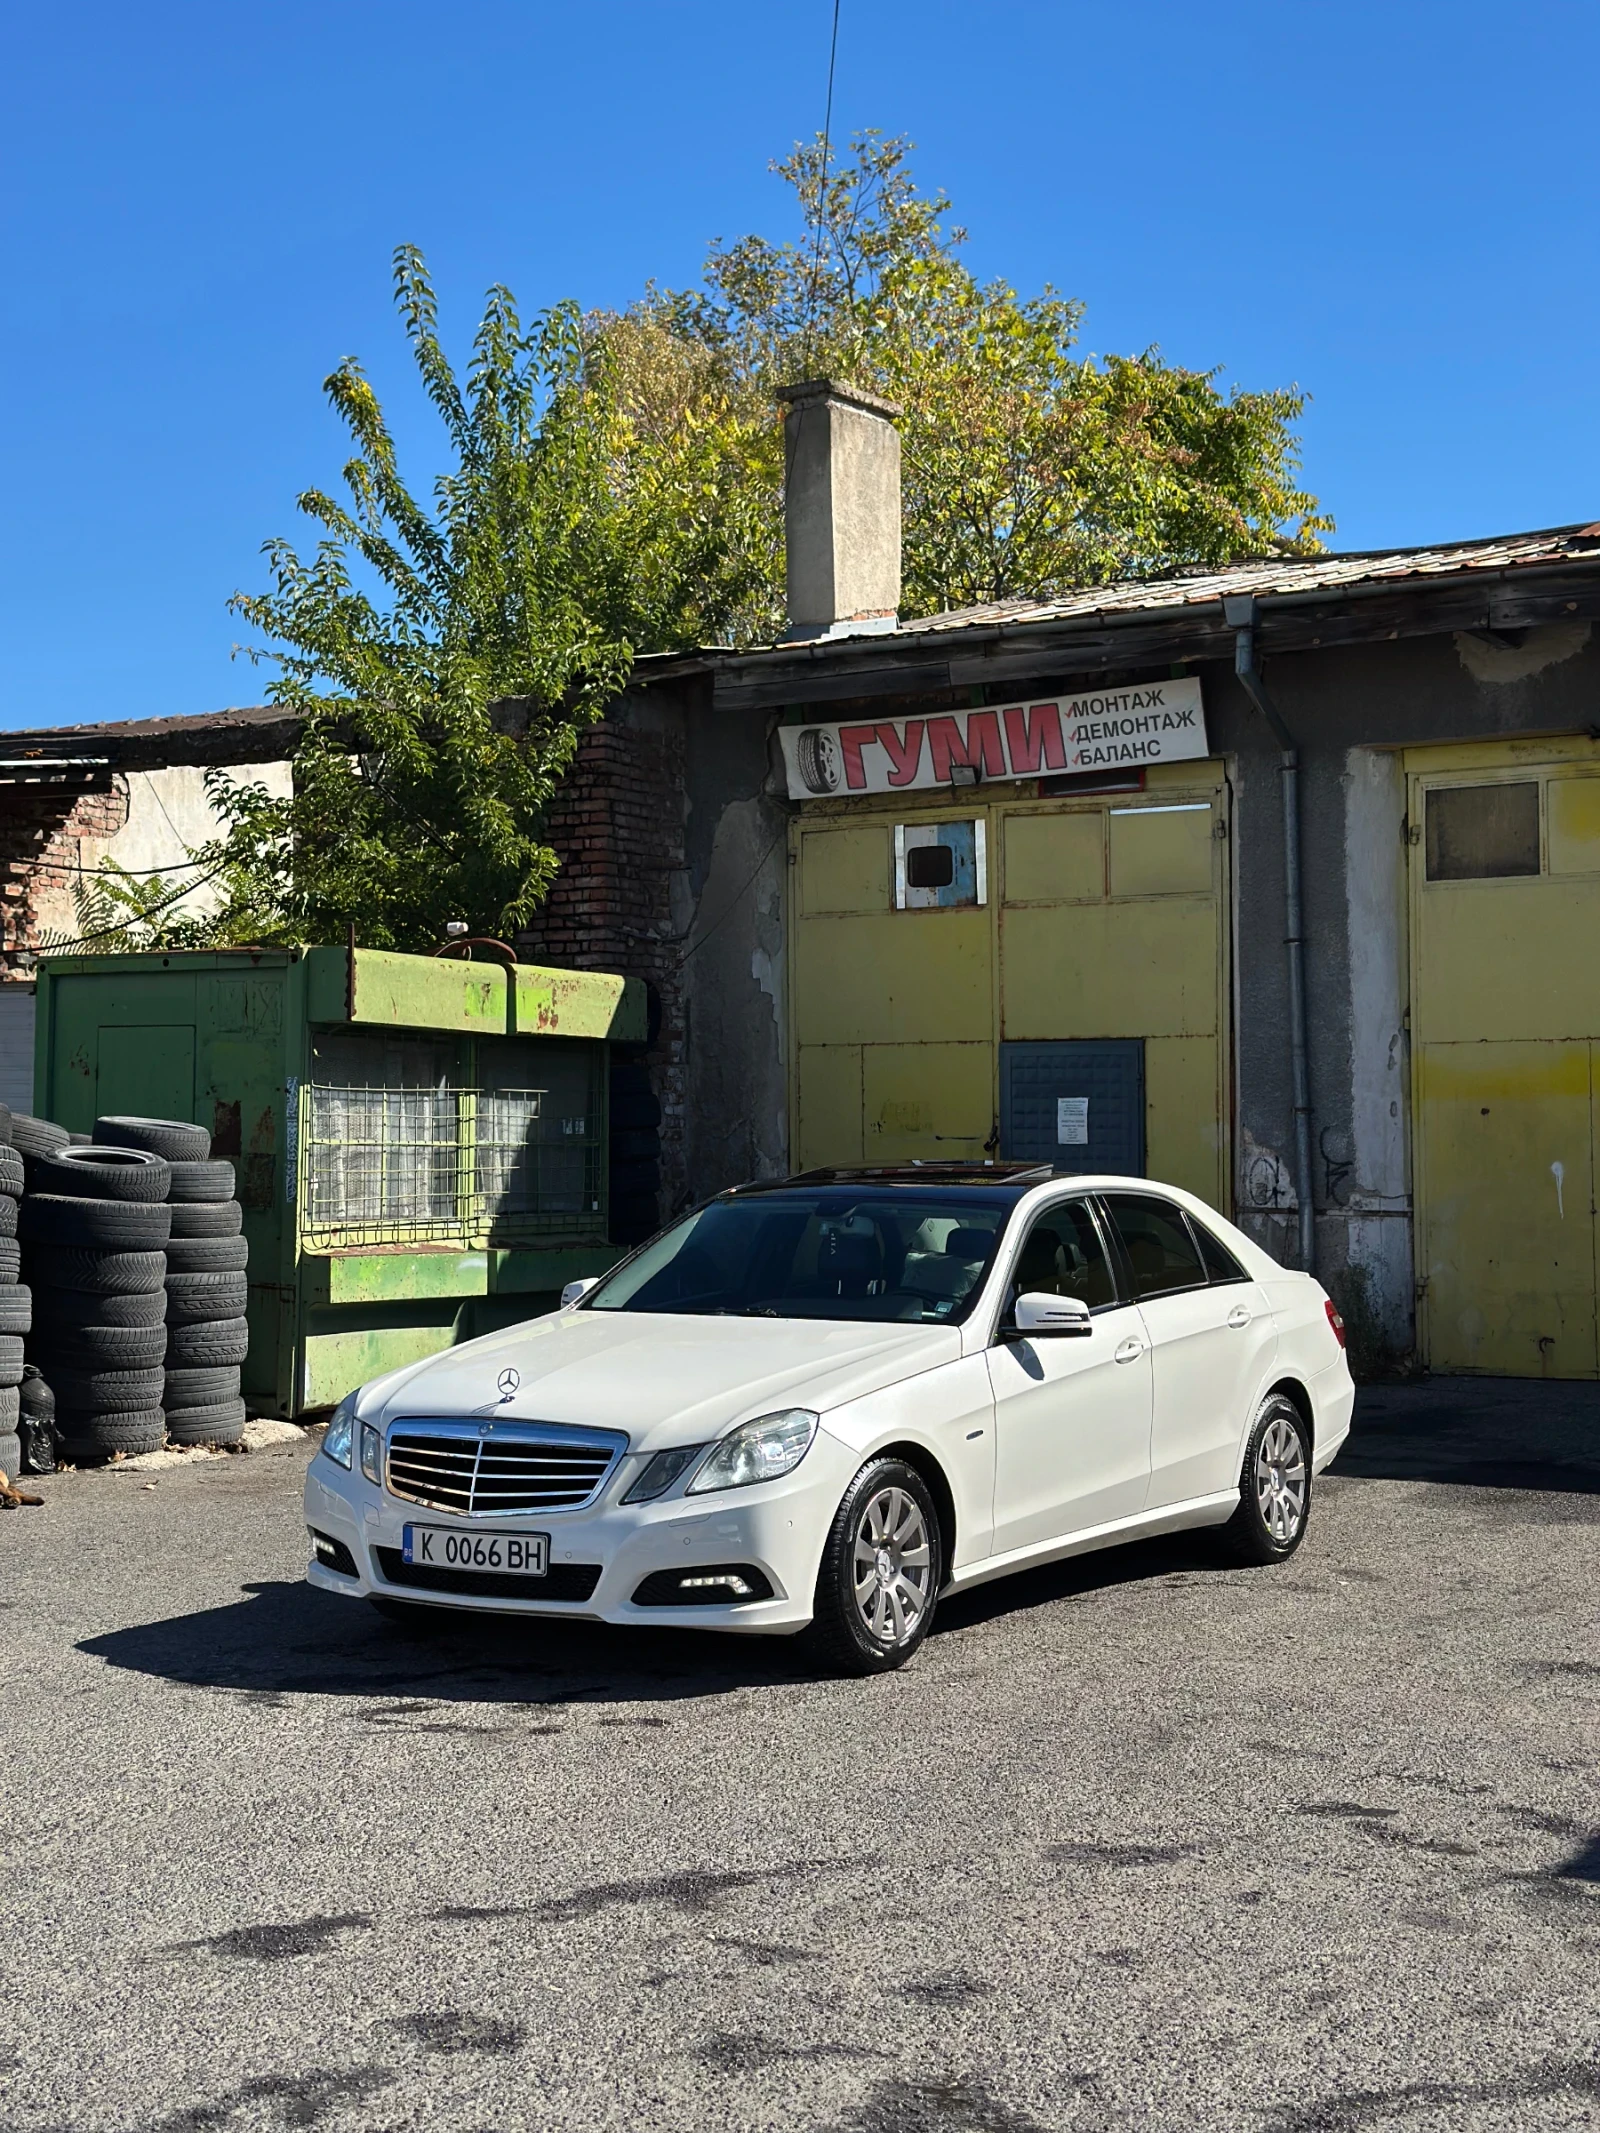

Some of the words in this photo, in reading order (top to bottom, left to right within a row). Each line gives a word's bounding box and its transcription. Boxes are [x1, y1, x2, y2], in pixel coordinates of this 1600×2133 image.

[1073, 690, 1165, 717] МОНТАЖ
[1077, 710, 1196, 745] ДЕМОНТАЖ
[838, 702, 1068, 790] ГУМИ
[1080, 740, 1161, 765] БАЛАНС
[422, 1532, 434, 1562] K
[445, 1537, 502, 1567] 0066
[507, 1540, 541, 1570] BH
